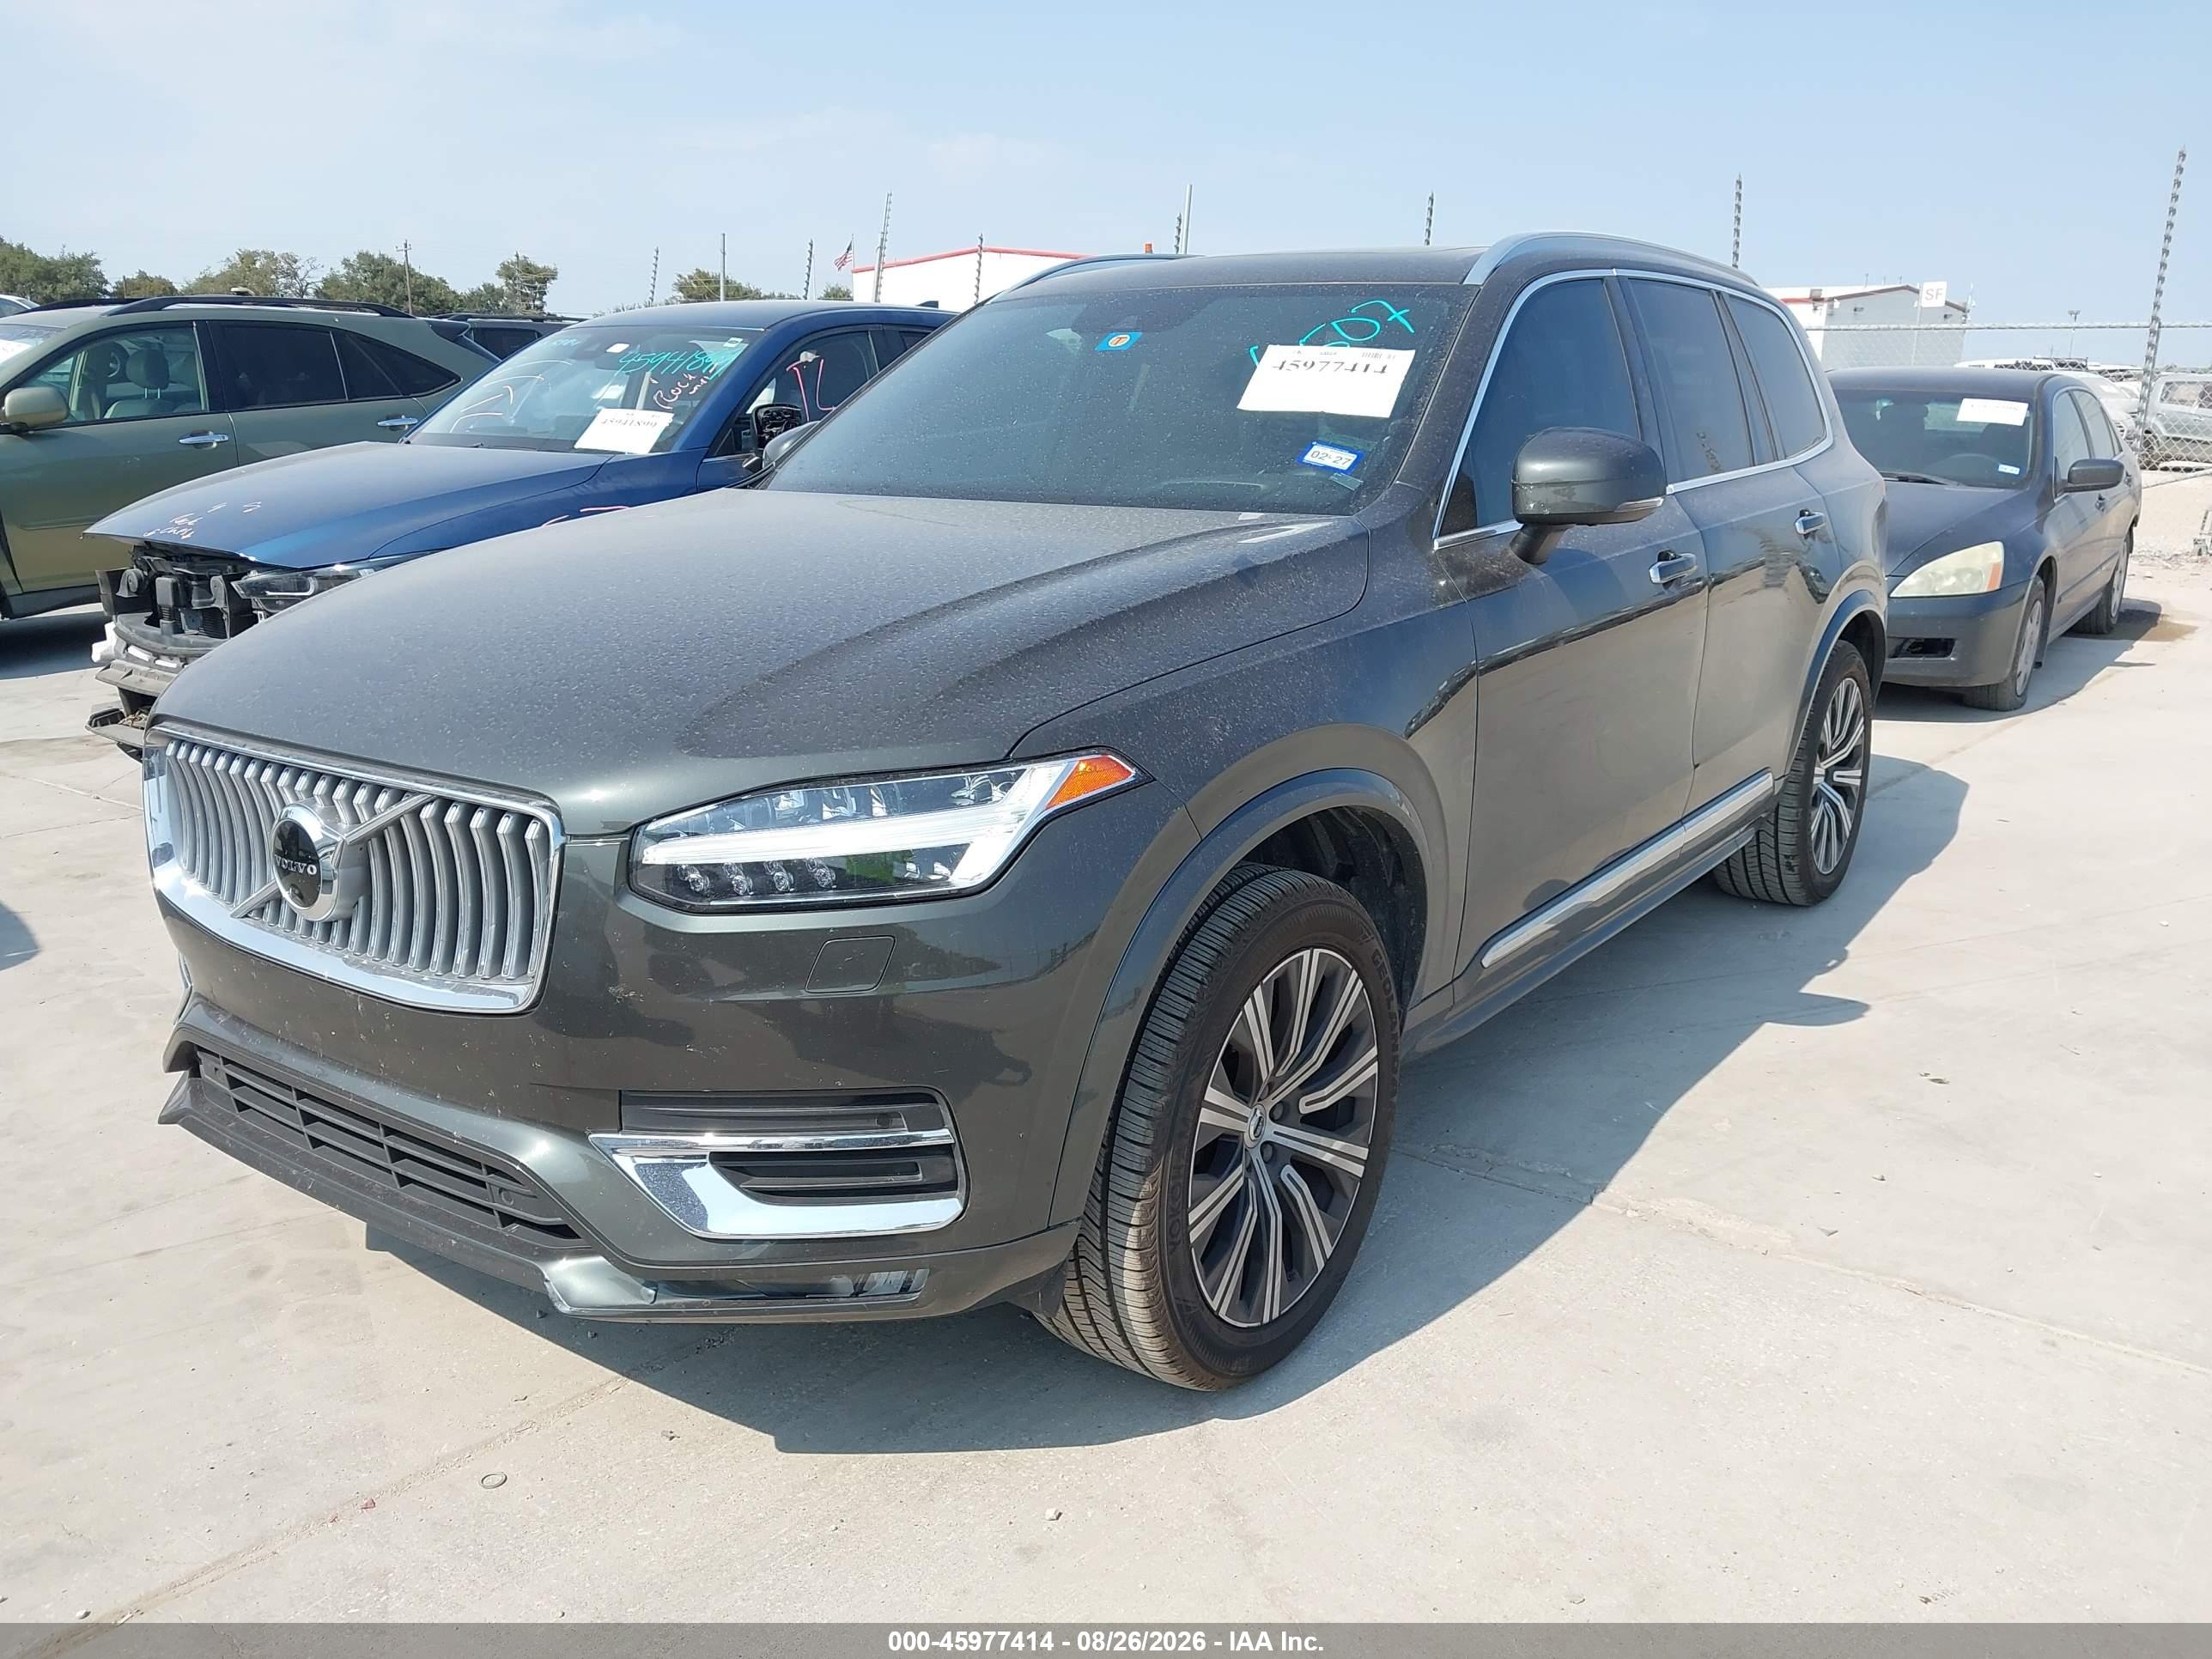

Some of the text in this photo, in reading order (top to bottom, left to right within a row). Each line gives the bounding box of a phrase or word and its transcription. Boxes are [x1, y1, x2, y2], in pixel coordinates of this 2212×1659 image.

[1925, 288, 1943, 301] SF
[1272, 360, 1388, 374] 45977414
[1310, 450, 1352, 466] 02 27
[274, 854, 318, 876] VOLVO
